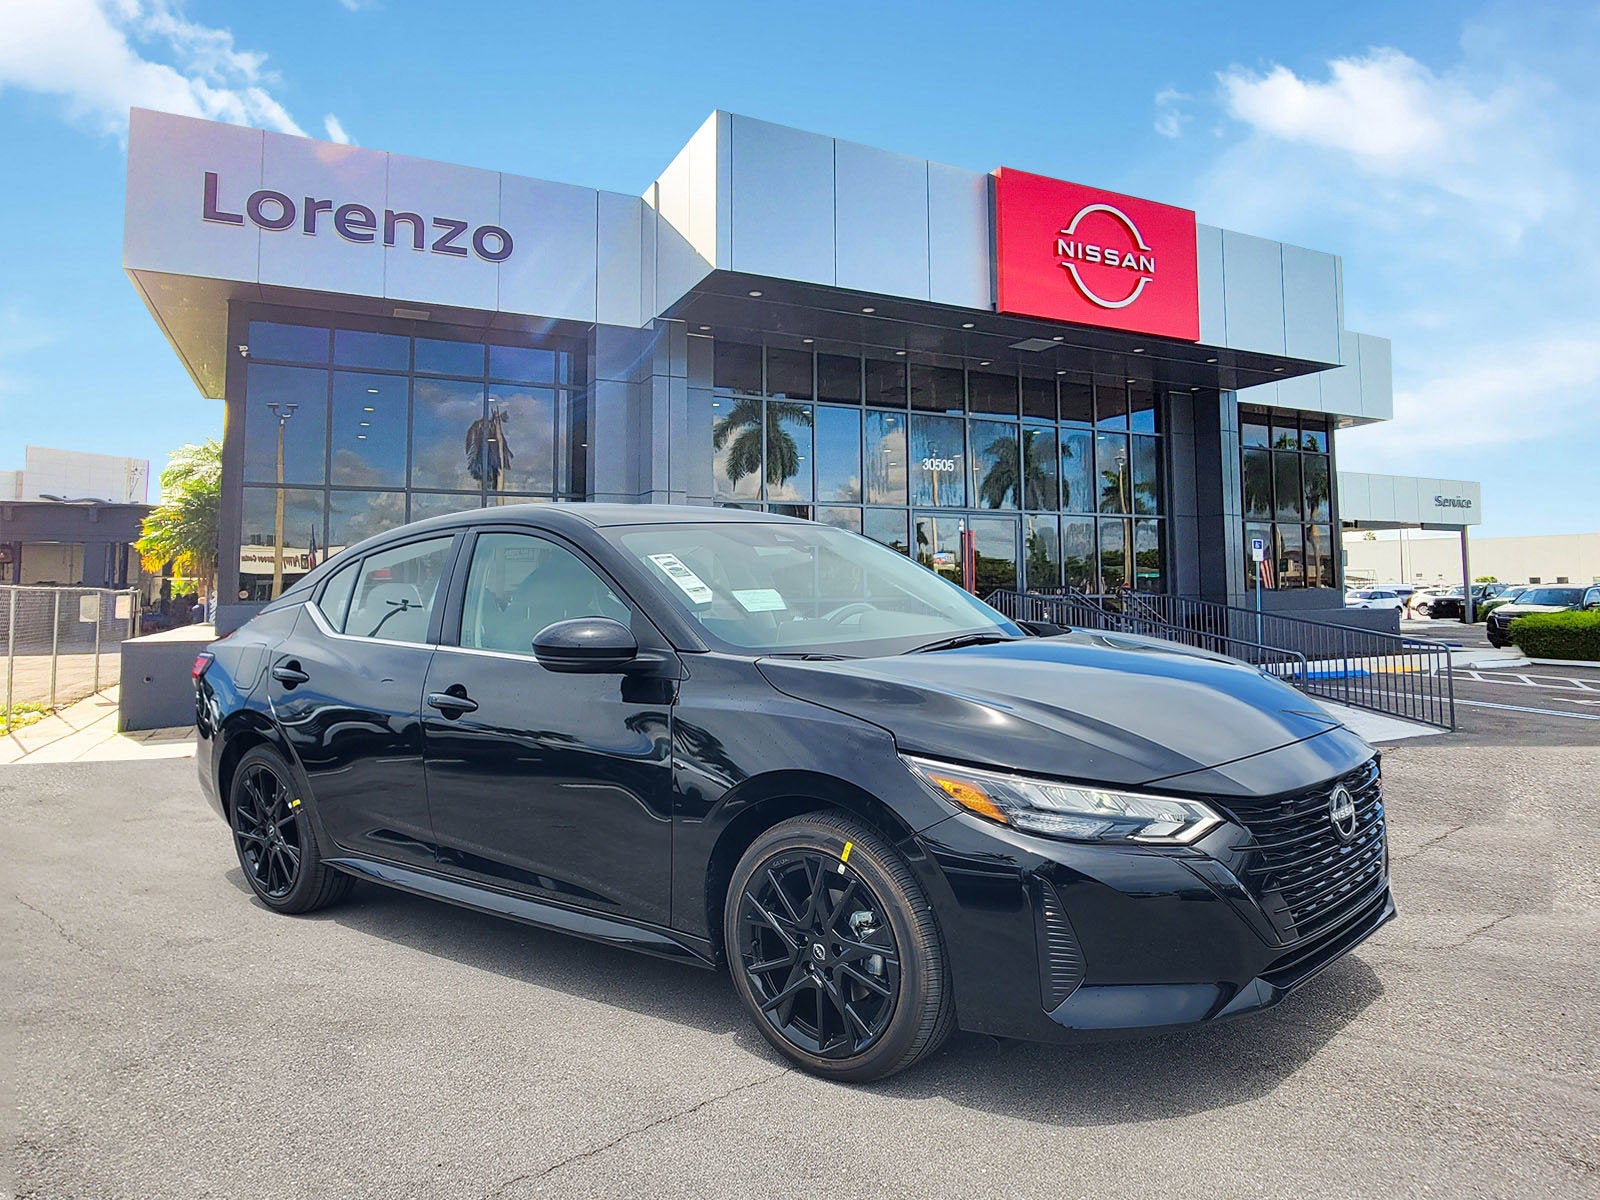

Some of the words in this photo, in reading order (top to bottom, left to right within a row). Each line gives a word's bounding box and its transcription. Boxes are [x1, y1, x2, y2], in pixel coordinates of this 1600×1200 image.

[202, 171, 514, 262] Lorenzo
[1057, 238, 1155, 273] NISSAN
[922, 457, 955, 471] 30505
[1434, 495, 1472, 508] Service
